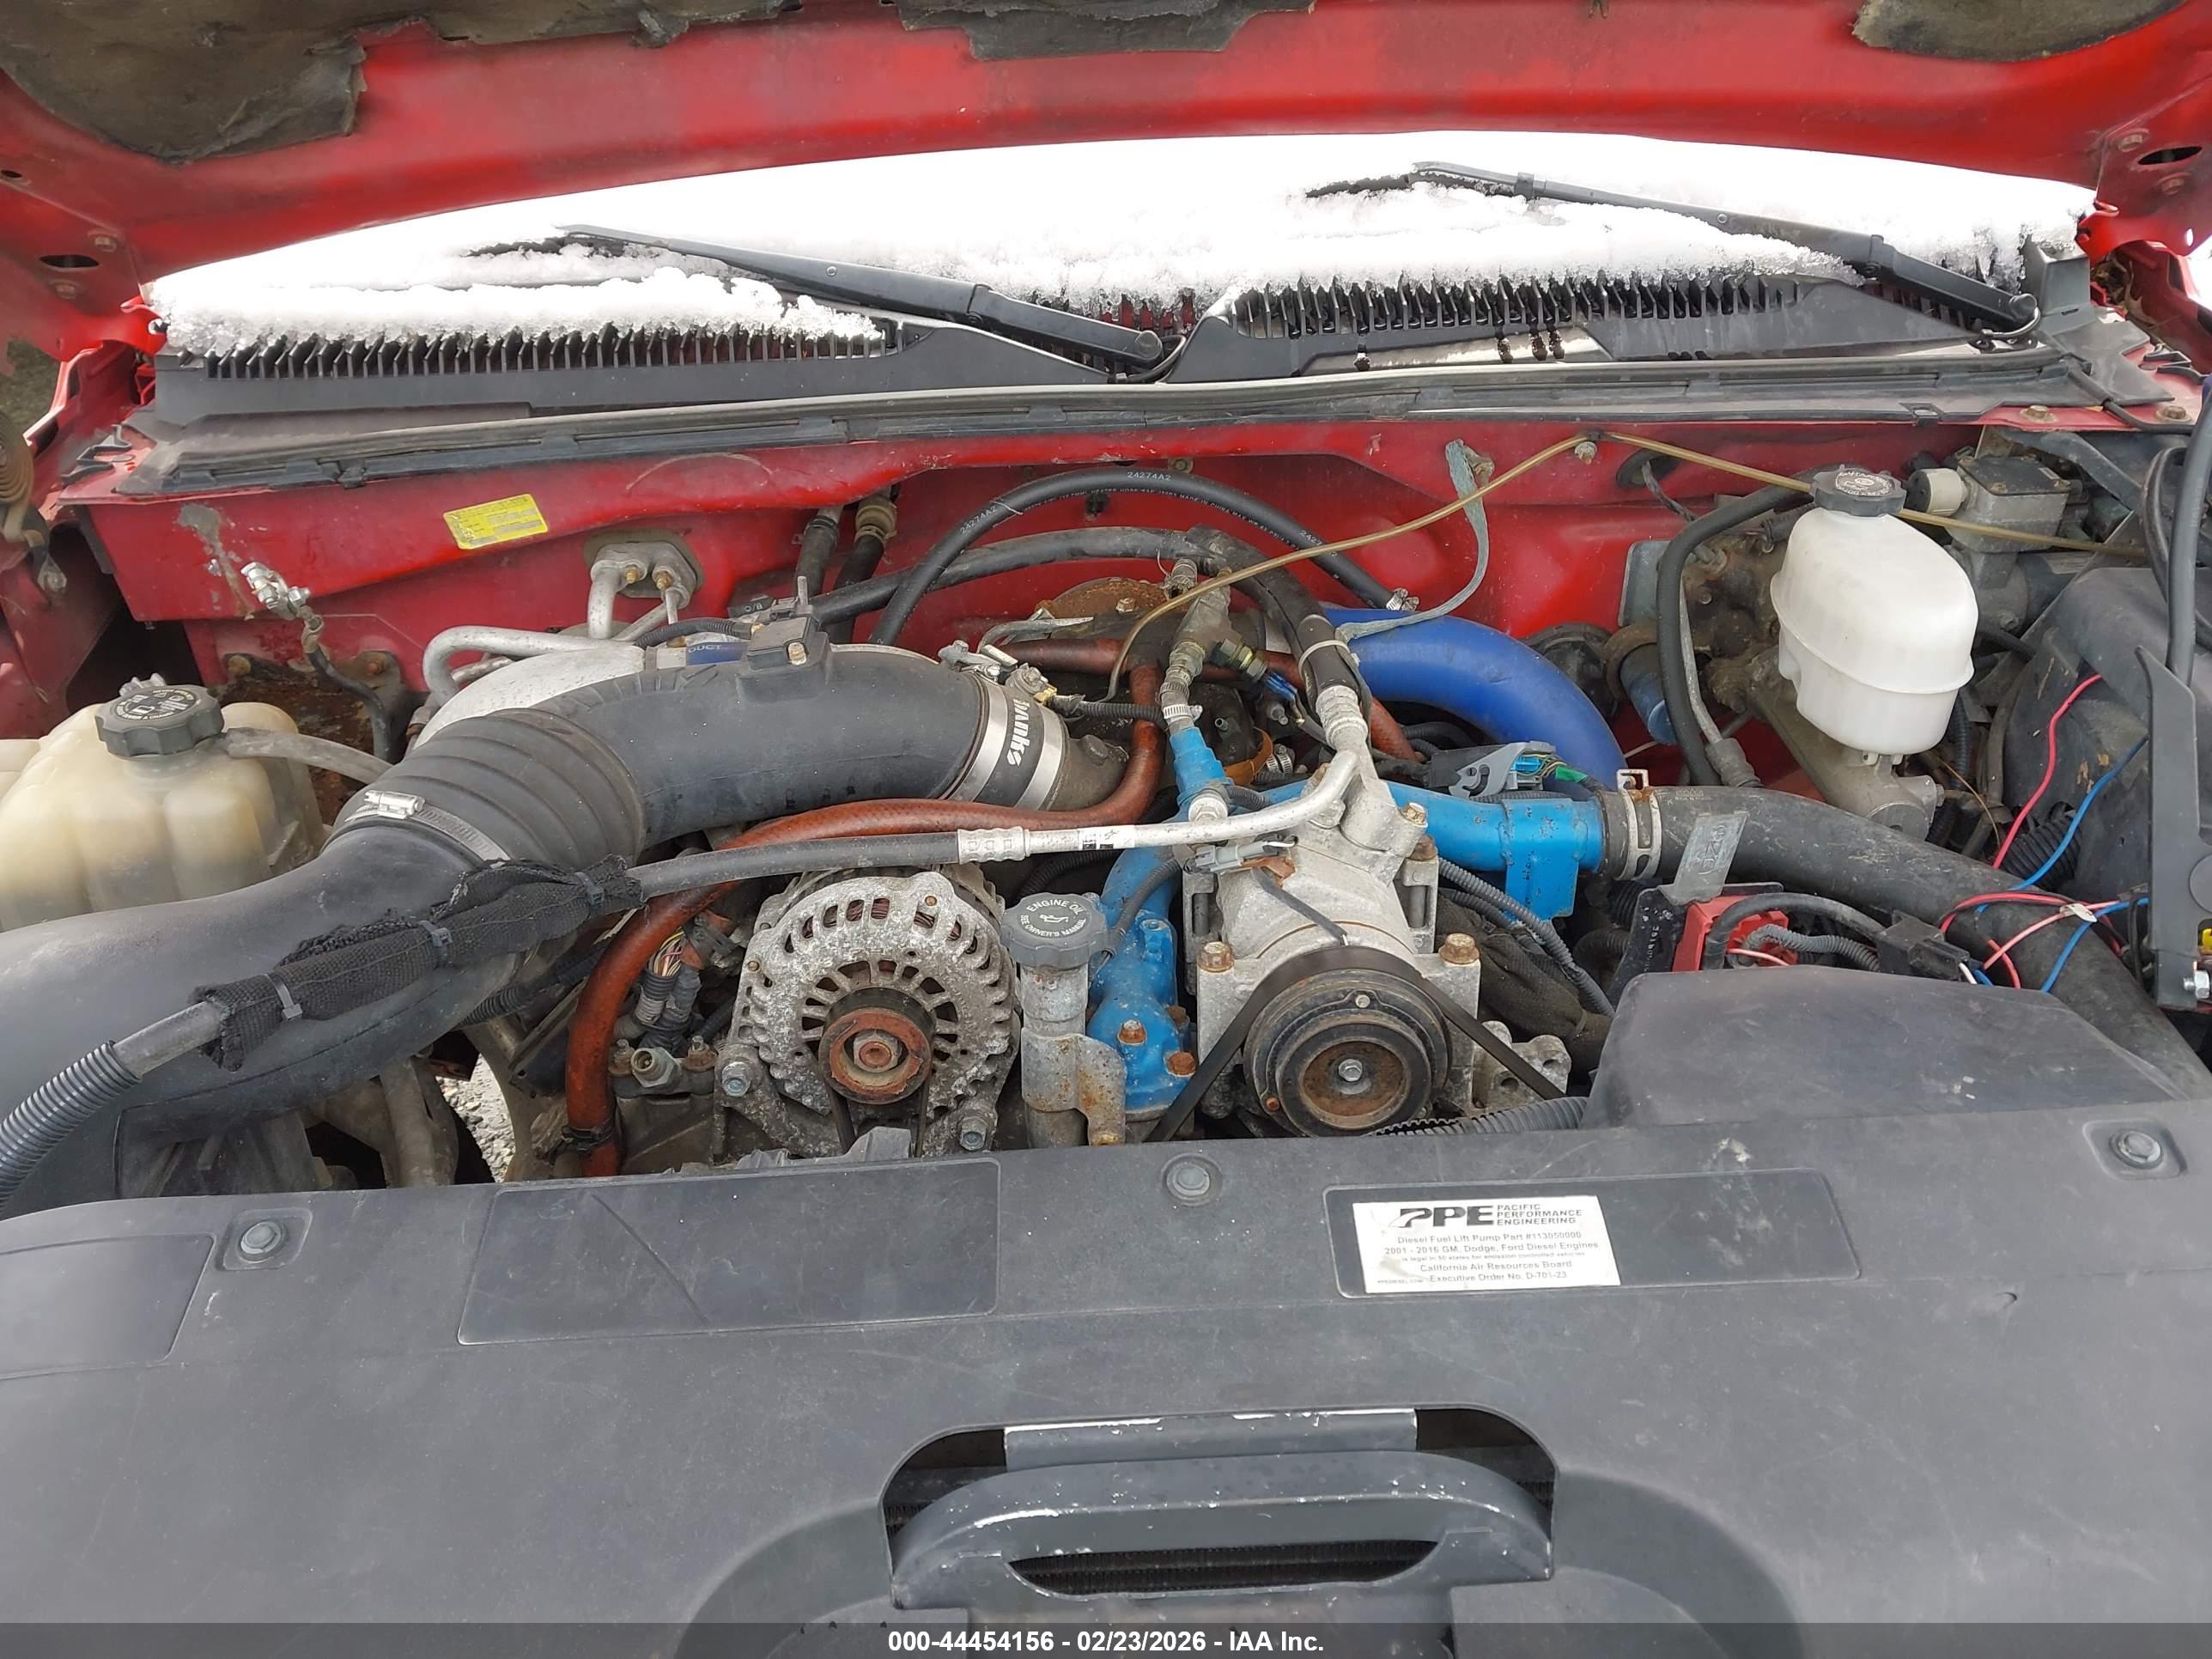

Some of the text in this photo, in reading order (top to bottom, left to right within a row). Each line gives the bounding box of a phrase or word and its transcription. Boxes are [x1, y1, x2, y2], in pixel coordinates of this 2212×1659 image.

[1127, 471, 1171, 481] 24274A2
[1026, 899, 1086, 915] ENGINE OIL
[1497, 1210, 1582, 1218] PERFORMANCE
[1497, 1218, 1577, 1226] ENGINEERING
[1472, 1234, 1500, 1243] Pump
[1526, 1243, 1557, 1251] Diesel
[1559, 1242, 1599, 1250] Engines
[1486, 1262, 1540, 1271] Resources
[1542, 1261, 1572, 1269] Board
[1478, 1273, 1504, 1282] Order
